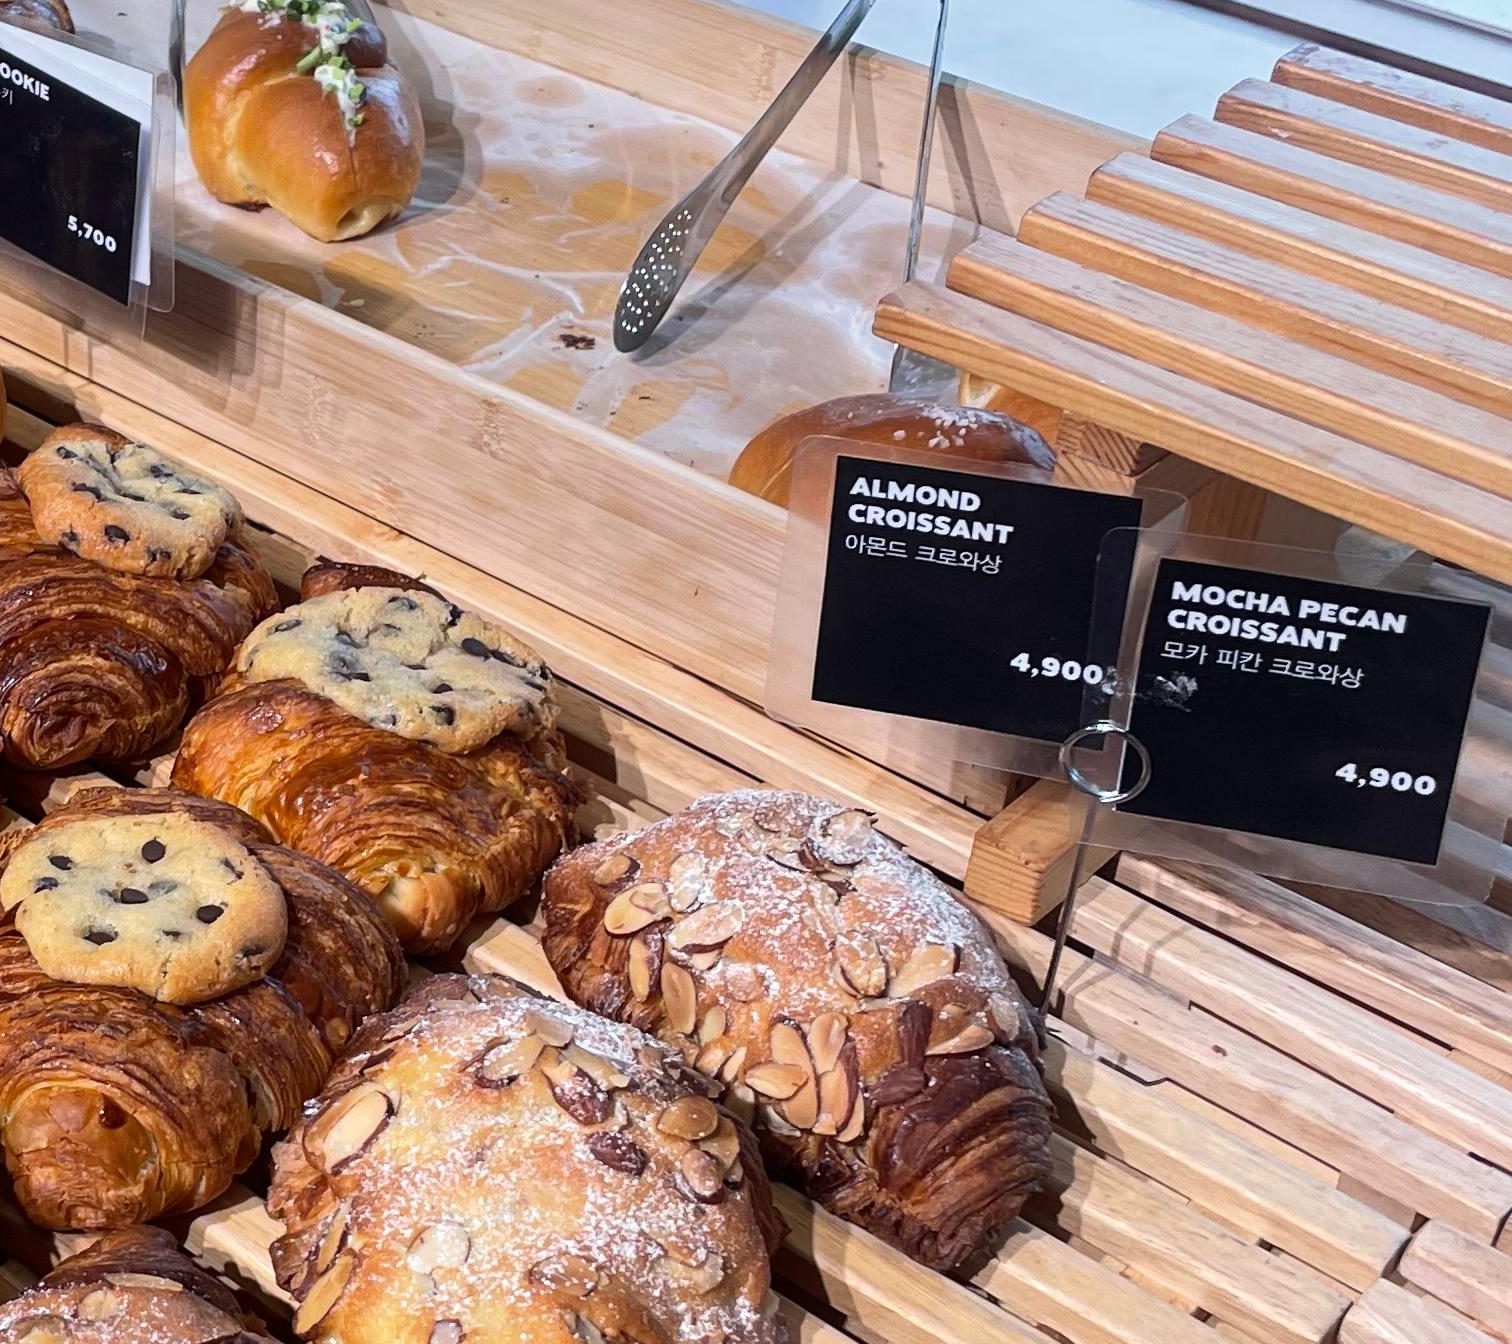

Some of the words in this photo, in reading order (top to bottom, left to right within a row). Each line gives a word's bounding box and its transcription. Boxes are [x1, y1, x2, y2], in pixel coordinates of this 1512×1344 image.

[67, 215, 117, 253] 5,700
[849, 477, 981, 512] ALMOND
[848, 503, 1014, 545] CROISSANT
[845, 534, 908, 558] 아몬드
[914, 545, 1003, 574] 크로와상
[1171, 581, 1290, 617] MOCHA
[1297, 599, 1408, 634] PECAN
[1167, 609, 1347, 652] CROISSANT
[1010, 652, 1103, 685] 4,900
[1160, 640, 1209, 665] 모카
[1216, 648, 1264, 673] 피칸
[1268, 657, 1364, 689] 크로와상
[1335, 762, 1437, 796] 4,900
